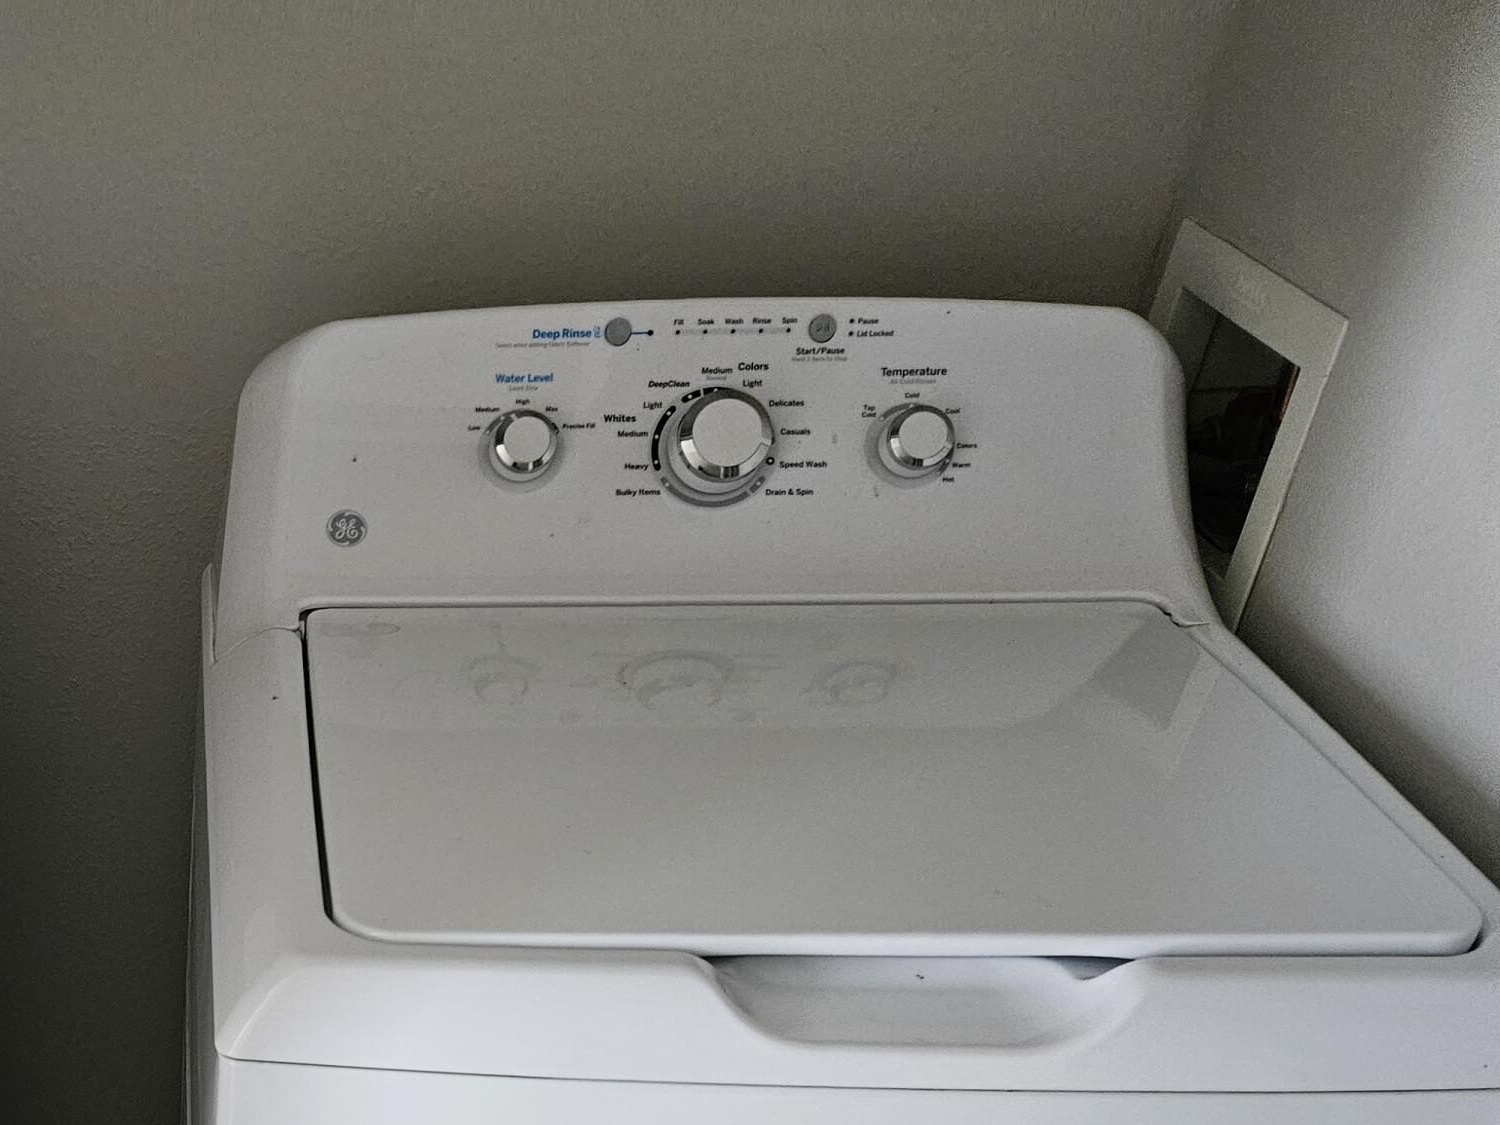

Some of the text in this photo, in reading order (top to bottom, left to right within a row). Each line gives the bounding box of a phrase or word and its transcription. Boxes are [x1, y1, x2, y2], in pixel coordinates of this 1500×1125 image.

[532, 328, 592, 340] Deep Rinse
[796, 347, 845, 356] Start/Pause
[702, 366, 733, 375] Medium
[738, 362, 769, 372] Colors
[882, 367, 948, 378] Temperature
[495, 373, 554, 384] Water Level
[648, 380, 690, 390] DeepClean
[742, 380, 763, 388] Light
[643, 402, 662, 411] Light
[604, 414, 636, 423] Whites
[618, 430, 648, 438] Medium
[780, 428, 811, 436] Casuals
[624, 463, 649, 472] Heavy
[780, 460, 828, 470] Speed Wash
[616, 488, 660, 497] Bulky Items
[796, 488, 814, 498] Spin
